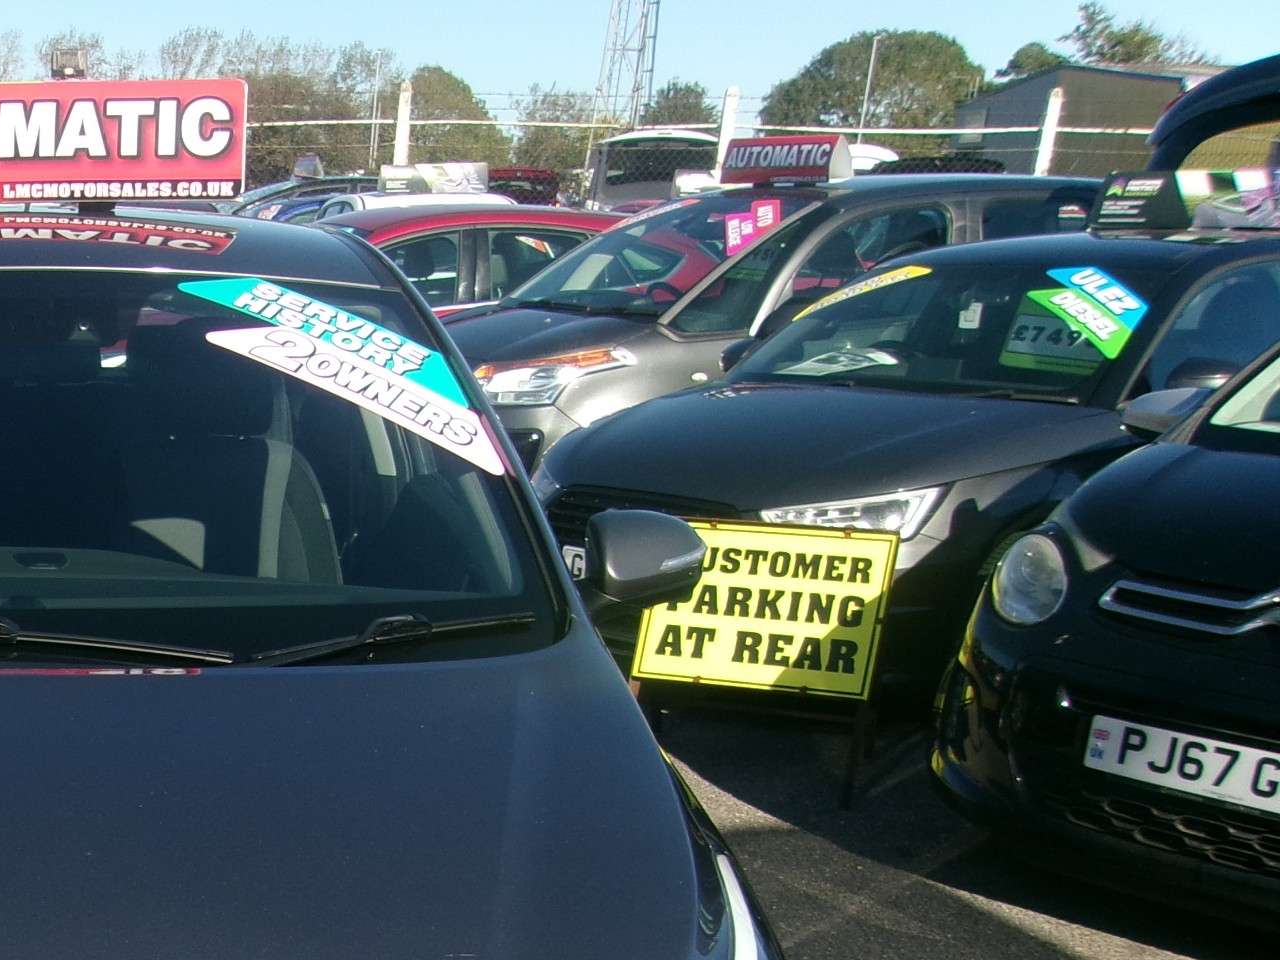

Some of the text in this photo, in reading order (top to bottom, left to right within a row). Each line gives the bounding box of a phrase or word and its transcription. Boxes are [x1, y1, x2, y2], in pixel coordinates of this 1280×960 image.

[725, 143, 831, 168] AUTOMATIC
[2, 181, 234, 200] LMCMOTORSALES.CO.UK
[1049, 291, 1119, 341] DIESEL
[1070, 266, 1141, 316] ULEZ
[231, 292, 421, 376] HISTORY
[251, 281, 431, 365] SERVICE
[248, 328, 478, 446] 2 OWNERS
[702, 546, 873, 584] USTOMER
[655, 624, 860, 675] AT REAR
[1117, 726, 1241, 787] PJ67
